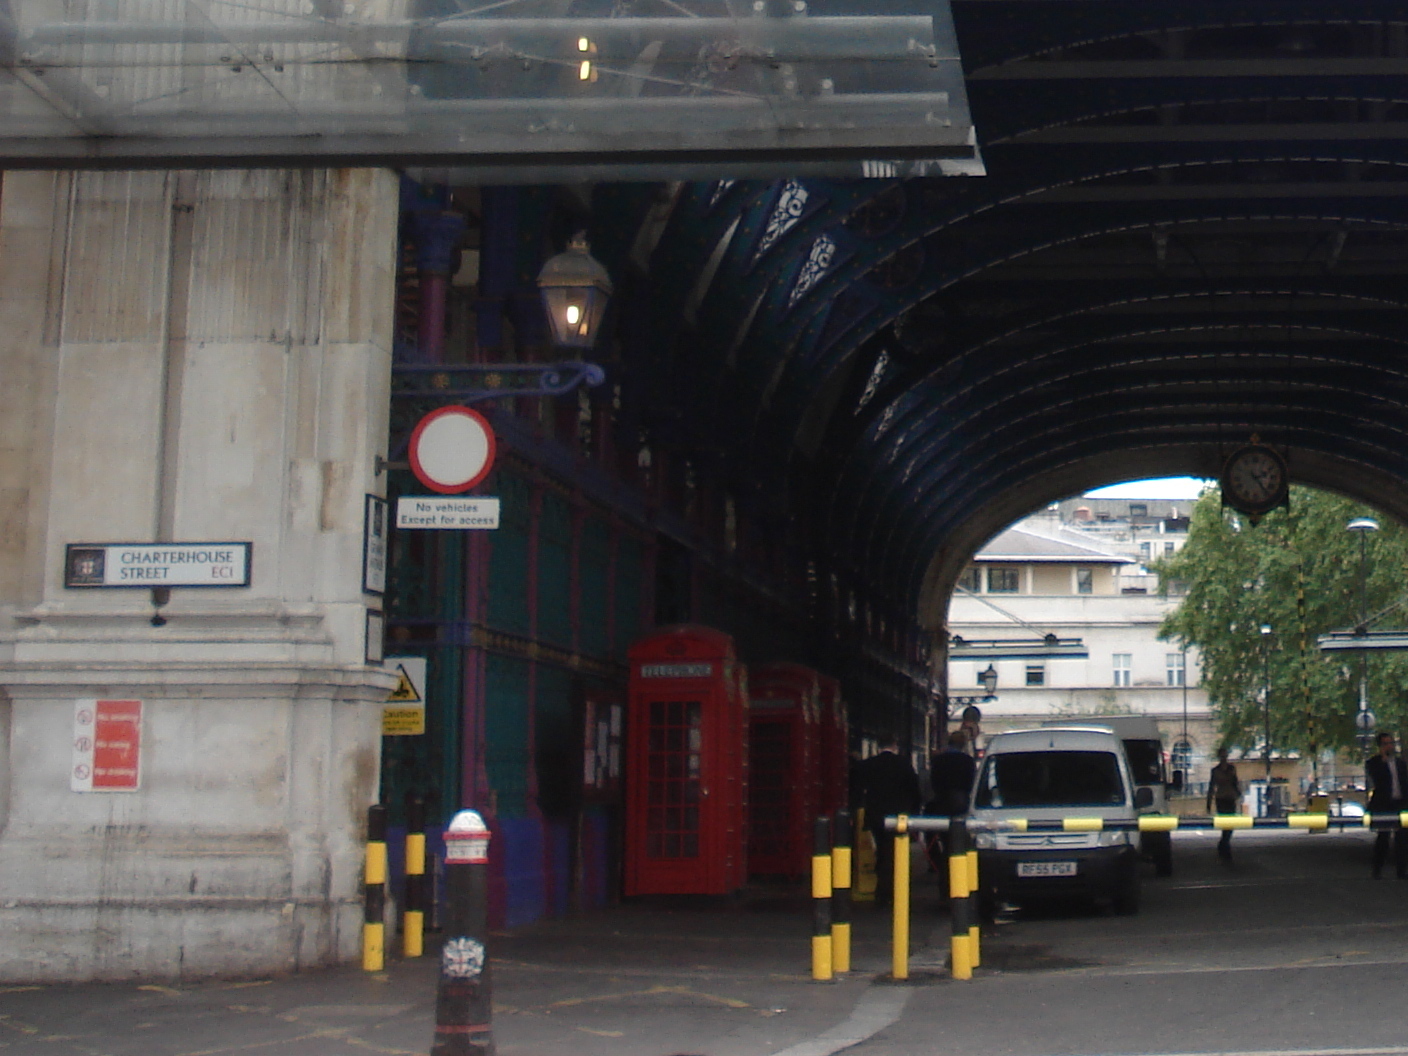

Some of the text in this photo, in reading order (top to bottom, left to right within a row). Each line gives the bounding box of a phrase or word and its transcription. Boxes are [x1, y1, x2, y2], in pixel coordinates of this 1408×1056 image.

[416, 503, 478, 512] No vehicles
[401, 515, 494, 525] Except for access
[121, 551, 233, 564] CHARTERHOUSE
[120, 567, 170, 580] STREET
